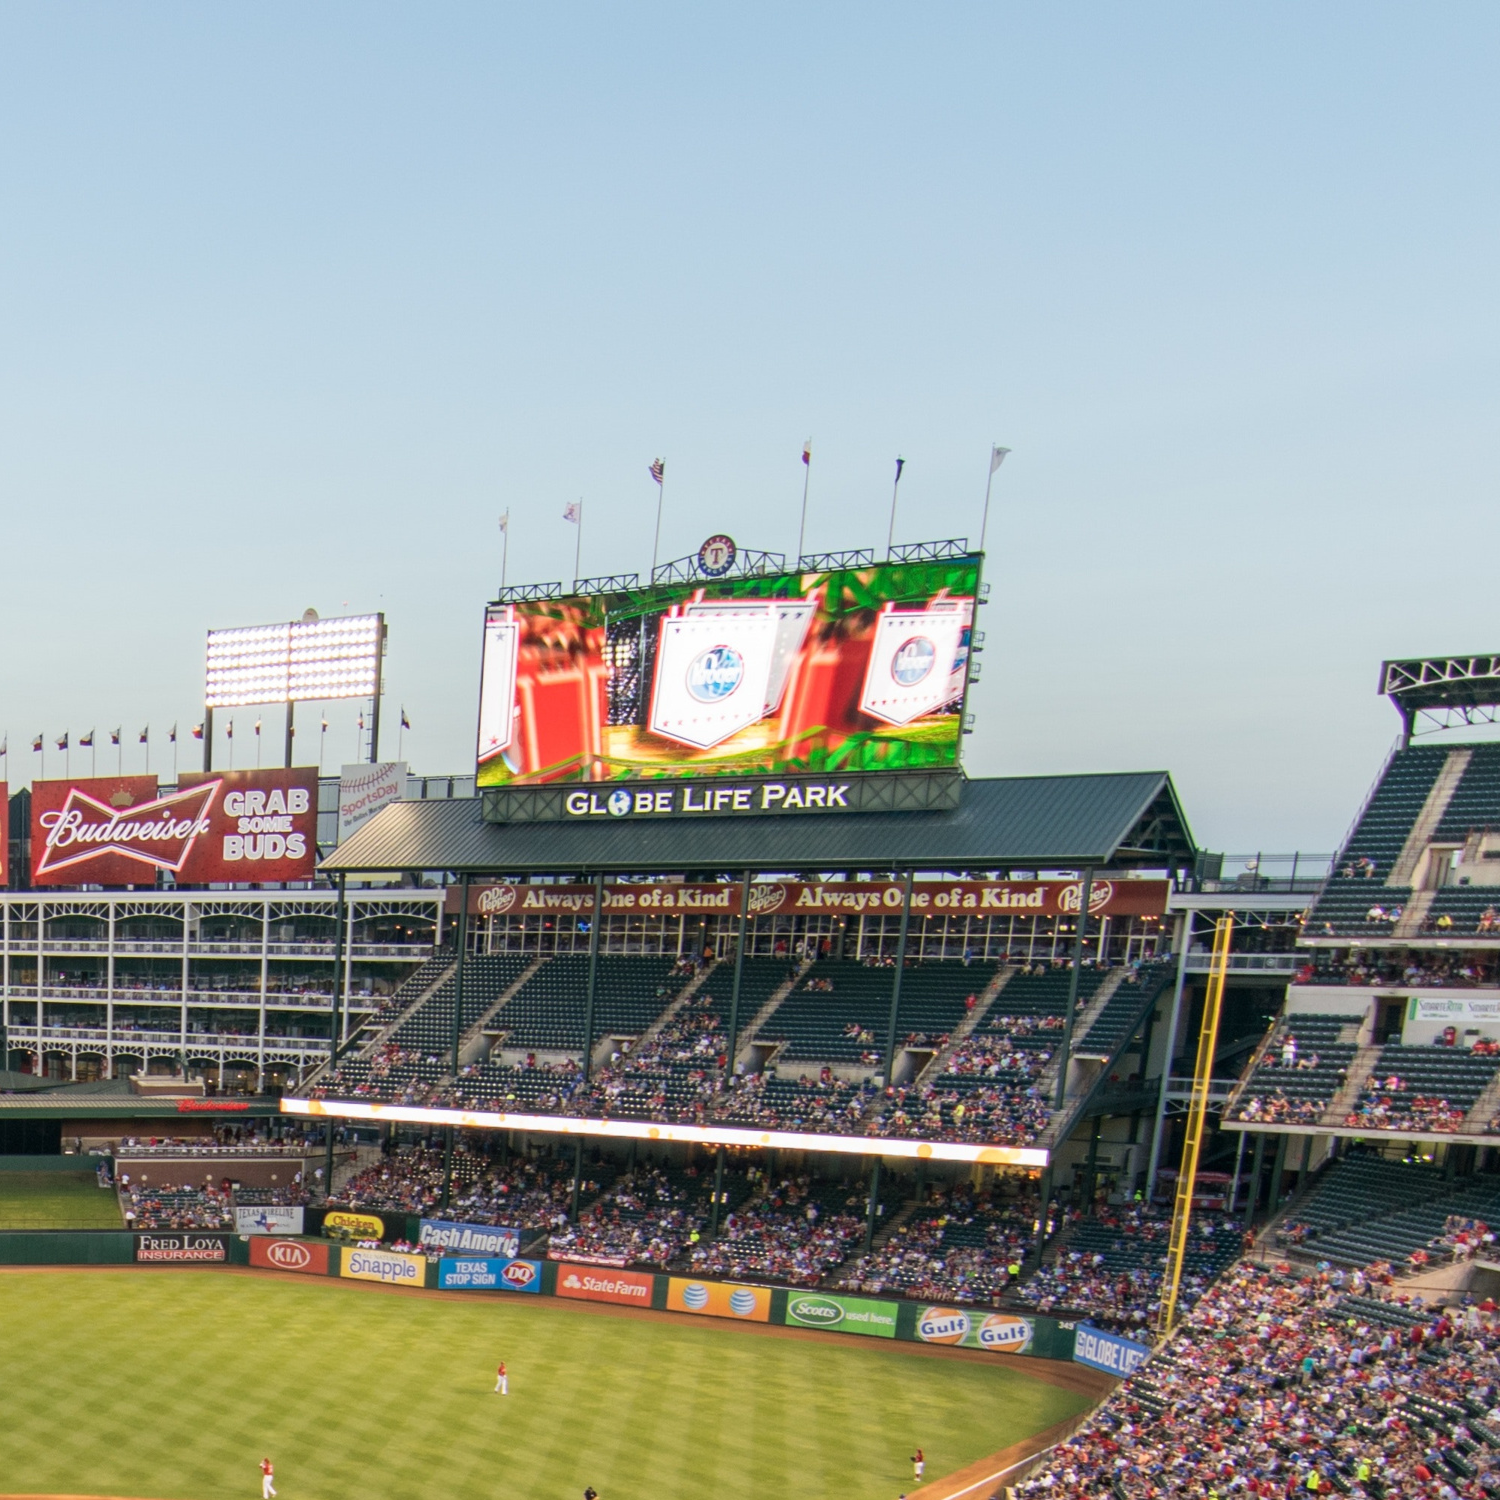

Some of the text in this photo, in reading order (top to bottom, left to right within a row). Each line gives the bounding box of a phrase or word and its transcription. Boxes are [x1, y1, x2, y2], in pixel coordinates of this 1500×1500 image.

[711, 548, 723, 565] T
[223, 788, 309, 817] GRAB
[341, 781, 399, 816] SportsDay
[566, 784, 849, 817] GLOBE LIFE PARK
[40, 809, 210, 848] Budweiser
[237, 815, 293, 834] SOME
[223, 833, 306, 861] BUDS
[757, 885, 773, 895] Dr
[795, 887, 1043, 911] Always of a Kind
[478, 887, 513, 912] Dr Pepper
[522, 888, 730, 911] Always One of a Kind
[238, 1208, 260, 1219] TEXAS
[333, 1215, 375, 1230] Chicken
[139, 1235, 224, 1250] FRED LOYA
[420, 1224, 457, 1248] Cash
[139, 1250, 223, 1260] INSURANCE
[274, 1246, 303, 1263] KIA
[350, 1253, 416, 1280] Snapple
[455, 1262, 487, 1273] TEXAS
[507, 1265, 530, 1281] DQ
[445, 1274, 495, 1285] STOP SIGN
[796, 1303, 895, 1325] Scotts used here.
[921, 1318, 966, 1335] Gulf
[980, 1326, 1026, 1343] Gulf
[1058, 1322, 1074, 1330] 349
[1085, 1335, 1117, 1369] GLOBE
